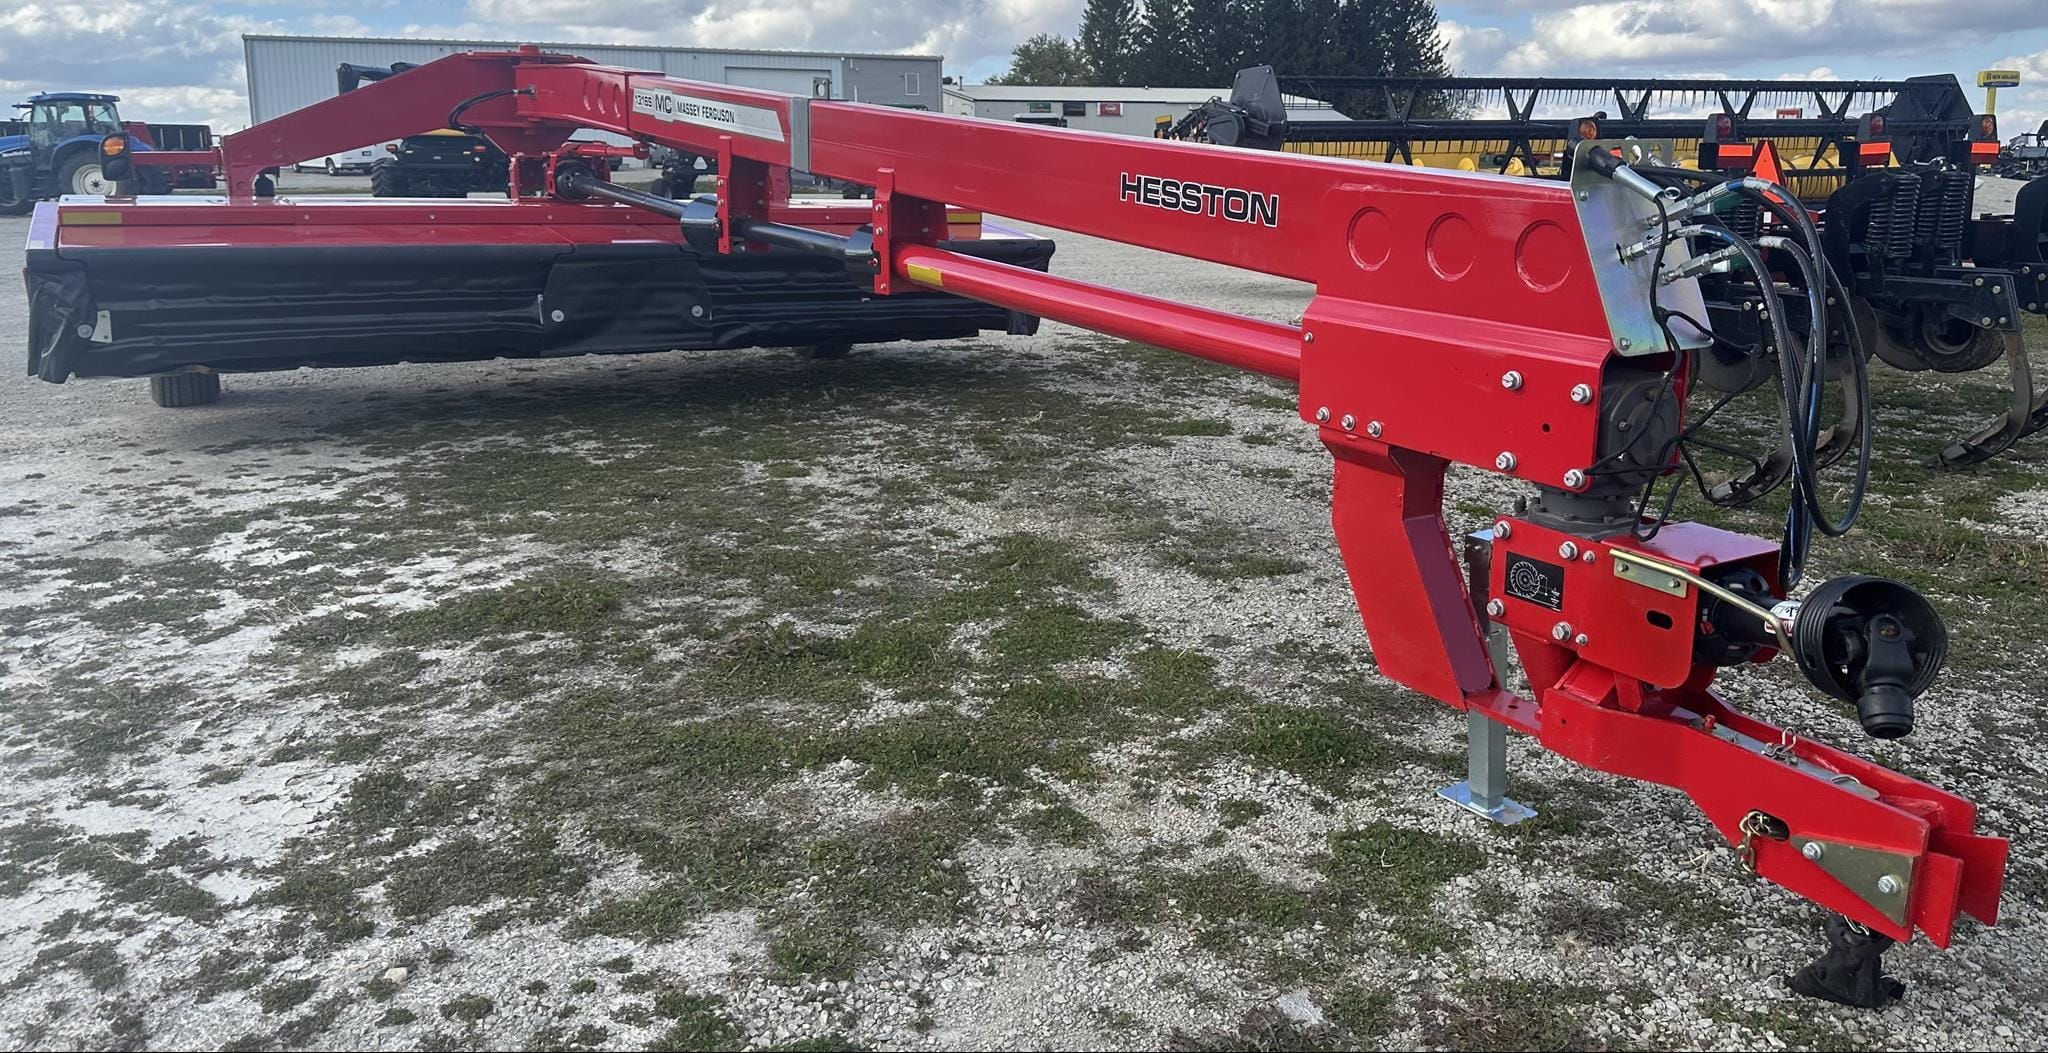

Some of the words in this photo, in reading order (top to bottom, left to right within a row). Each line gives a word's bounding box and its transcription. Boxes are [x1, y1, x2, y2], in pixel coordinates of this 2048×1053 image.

[655, 94, 672, 114] MC
[677, 102, 701, 117] MASSEY
[701, 106, 735, 123] FERGUSON
[1120, 172, 1279, 228] HESSTON
